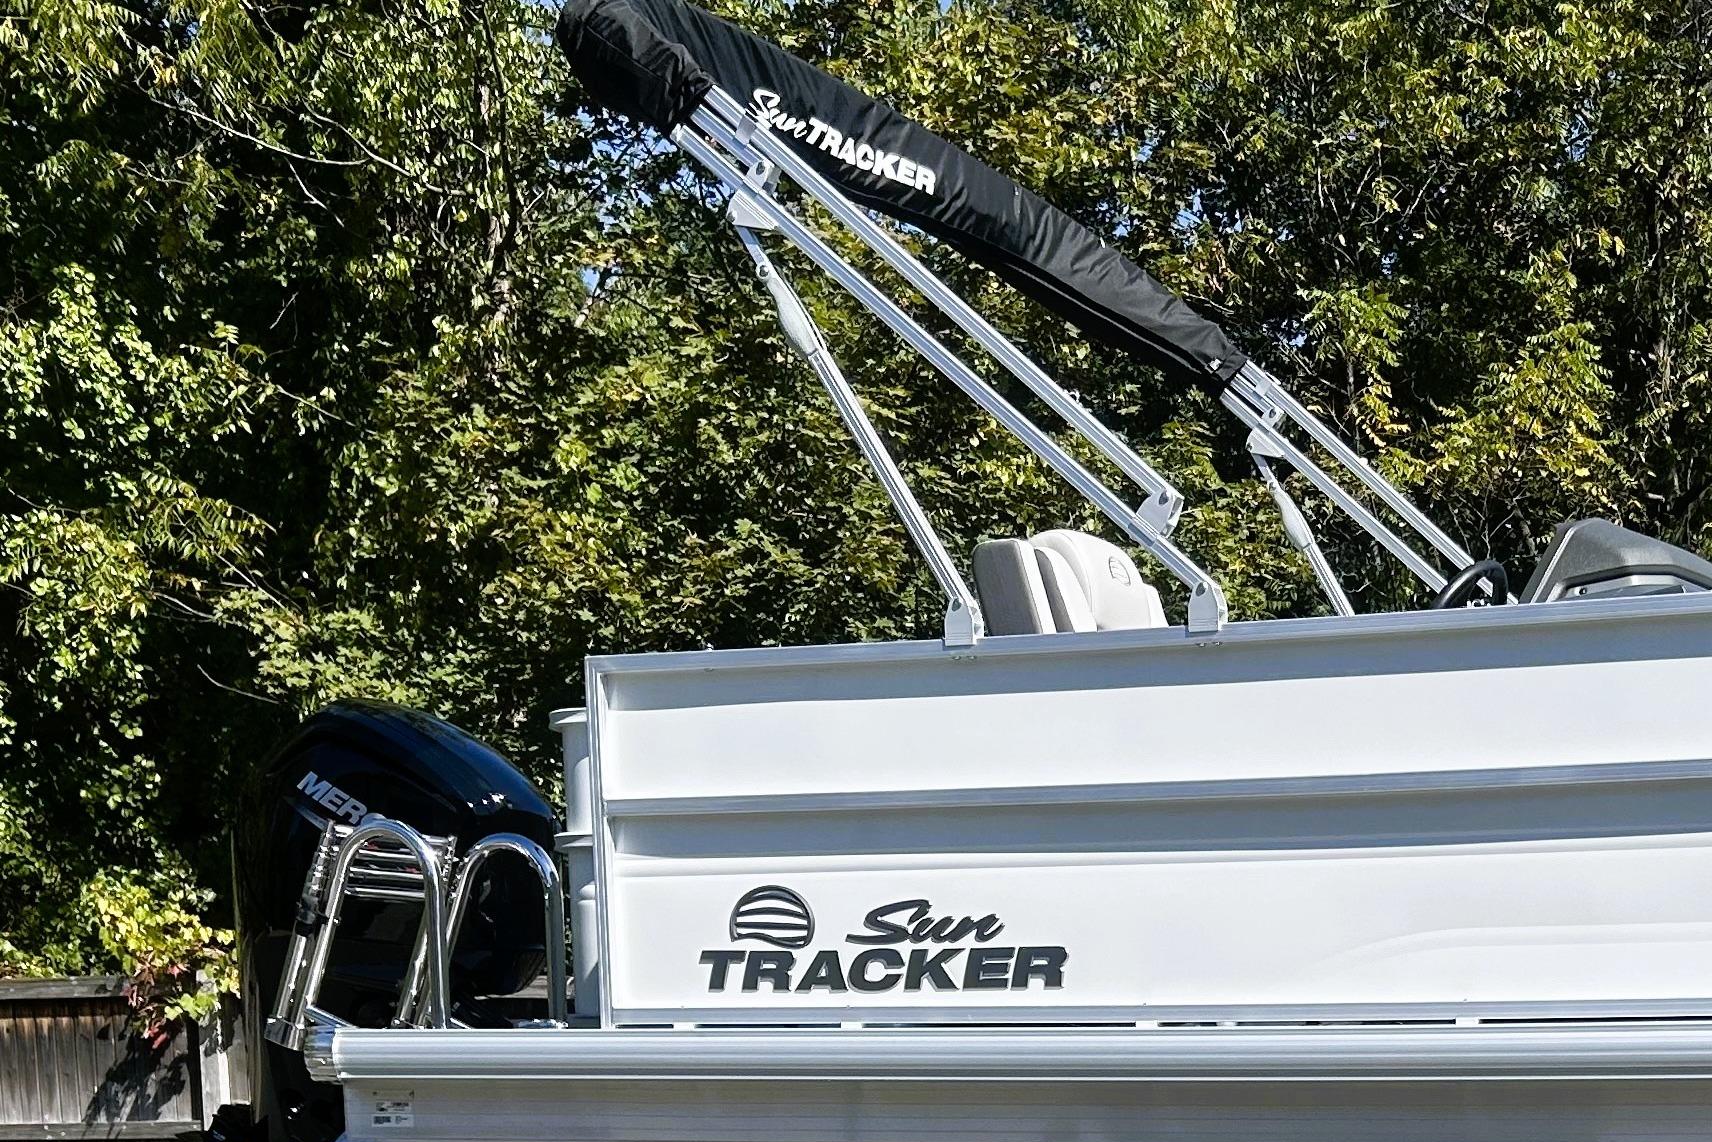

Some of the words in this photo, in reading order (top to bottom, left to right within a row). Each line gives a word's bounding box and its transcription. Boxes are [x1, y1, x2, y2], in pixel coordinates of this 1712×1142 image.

[745, 88, 807, 139] Sun
[806, 116, 937, 196] TRACKER
[845, 898, 1005, 946] Sun
[699, 945, 1069, 994] TRACKER
